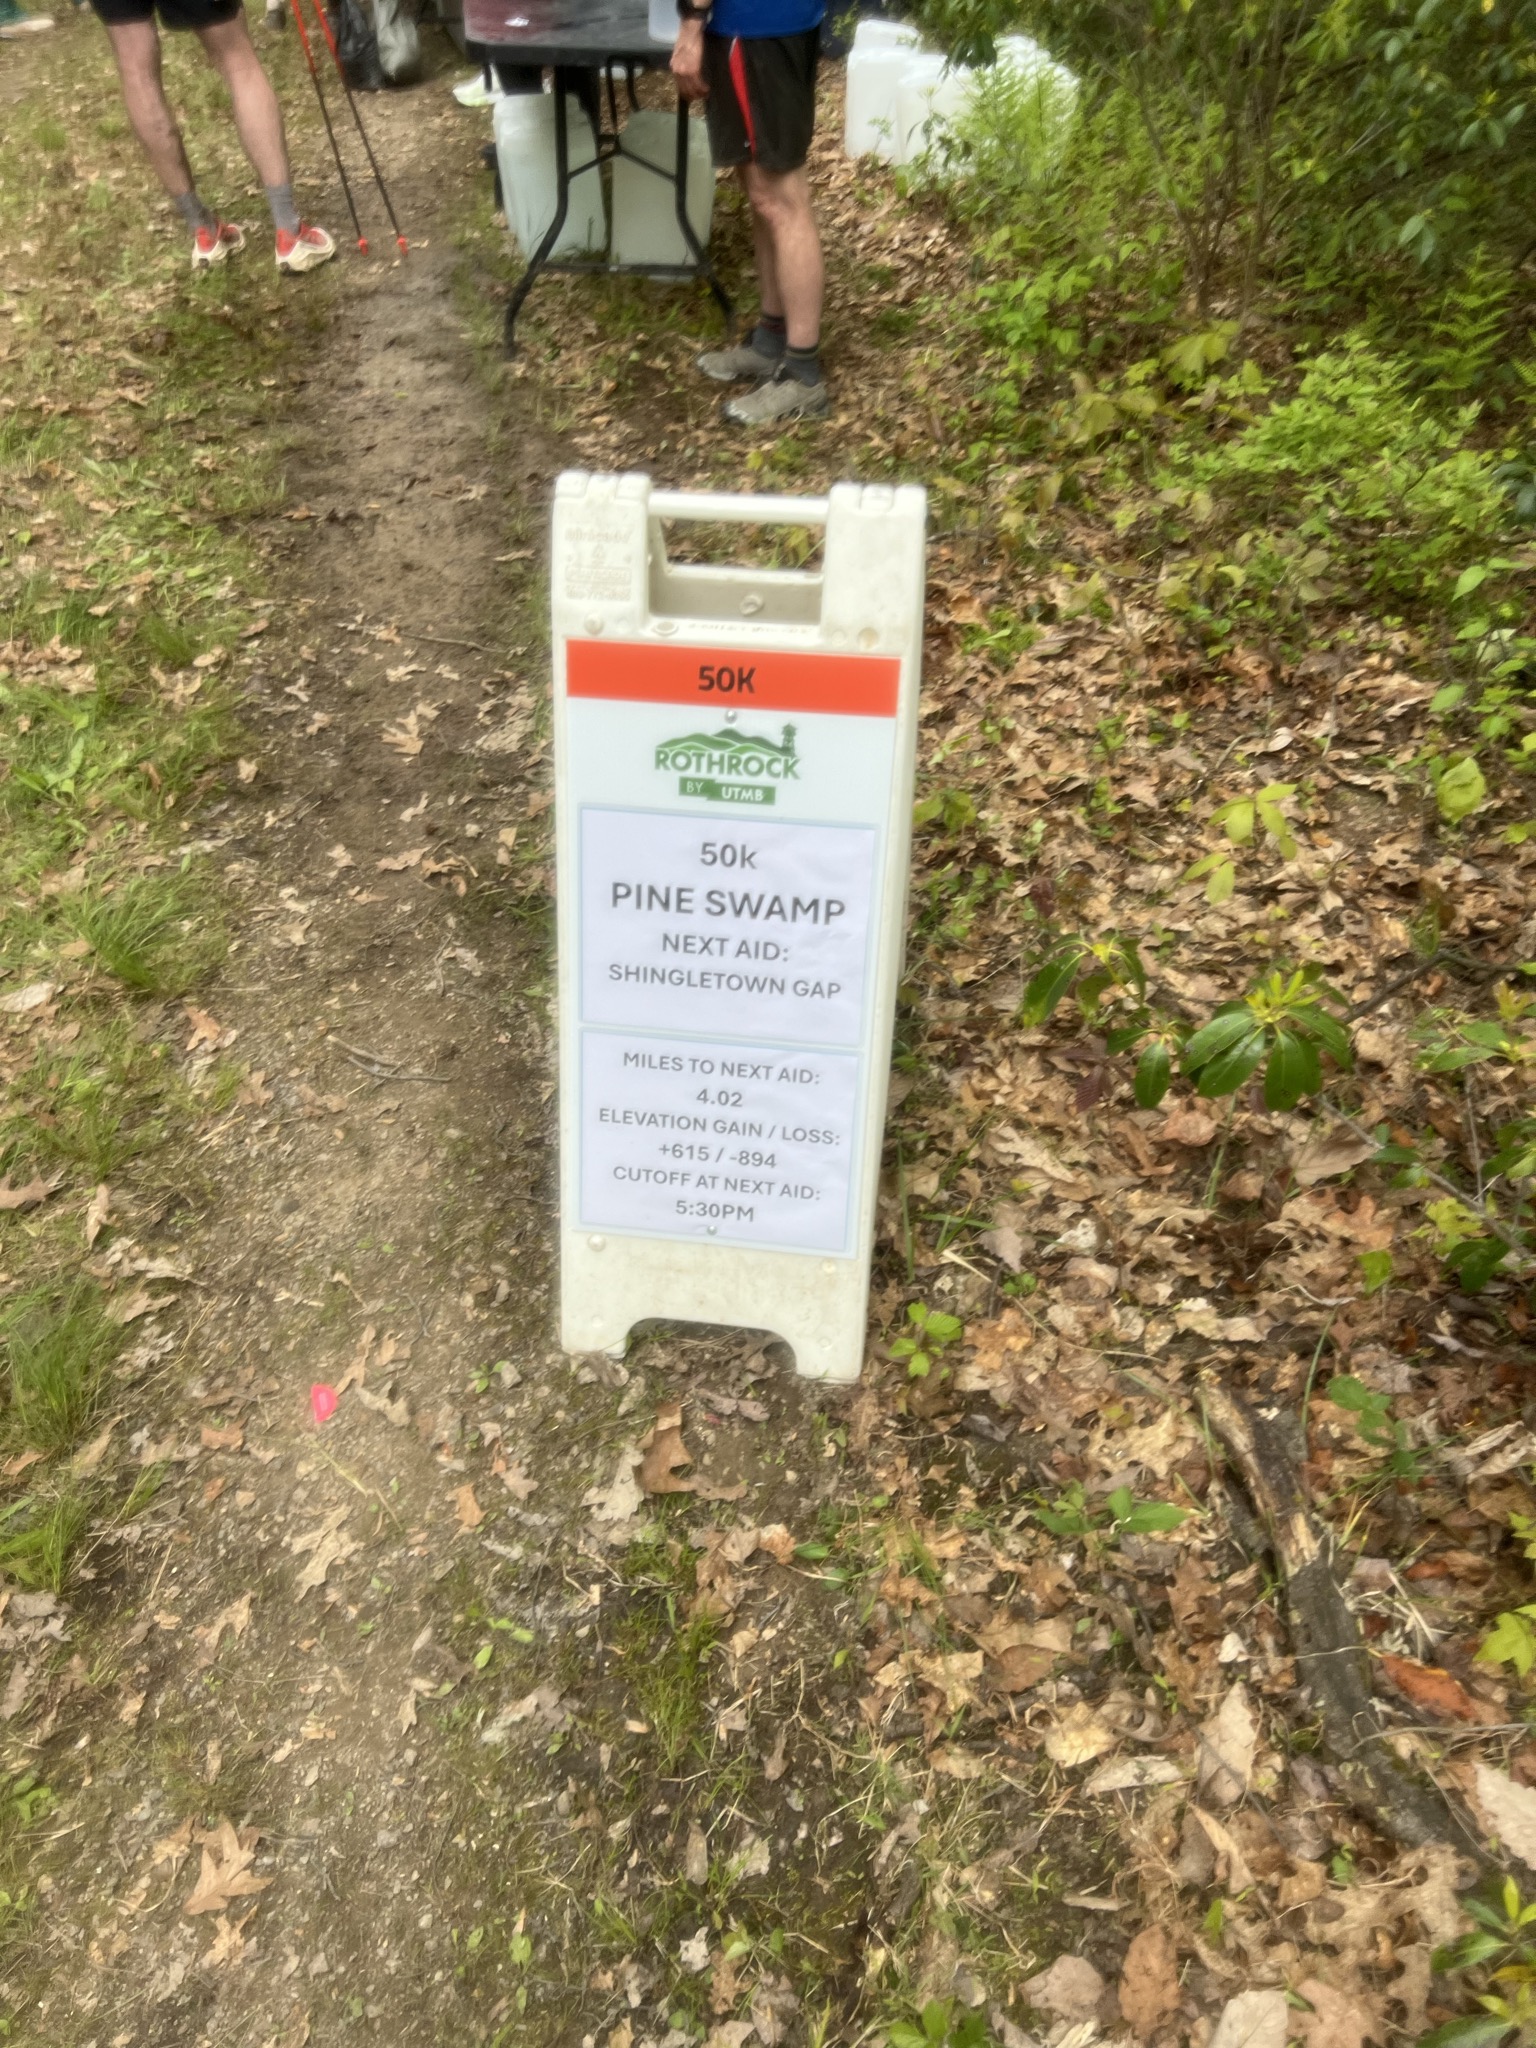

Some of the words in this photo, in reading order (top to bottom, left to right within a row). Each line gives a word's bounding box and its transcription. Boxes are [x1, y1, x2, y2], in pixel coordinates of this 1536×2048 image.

[698, 665, 757, 694] 50K
[654, 748, 801, 780] ROTHROCK
[686, 777, 704, 794] BY
[721, 786, 765, 803] UTMB
[700, 842, 758, 870] 50k
[611, 882, 695, 914] PINE
[704, 890, 846, 926] SWAMP
[661, 932, 730, 957] NEXT
[734, 938, 790, 962] AID:
[608, 963, 786, 995] SHINGLETOWN
[793, 979, 842, 1000] GAP
[623, 1052, 684, 1072] MILES
[688, 1058, 715, 1075] TO
[721, 1062, 774, 1081] NEXT
[777, 1067, 821, 1085] AID:
[696, 1088, 743, 1108] 4.02
[599, 1108, 707, 1133] ELEVATION
[713, 1119, 763, 1138] GAIN
[782, 1126, 841, 1146] LOSS:
[658, 1142, 709, 1162] +615
[729, 1150, 777, 1169] -894
[613, 1165, 692, 1187] CUTOFF
[695, 1174, 719, 1190] AT
[724, 1178, 775, 1196] NEXT
[779, 1183, 822, 1201] AID:
[675, 1199, 755, 1222] 5:30PM
